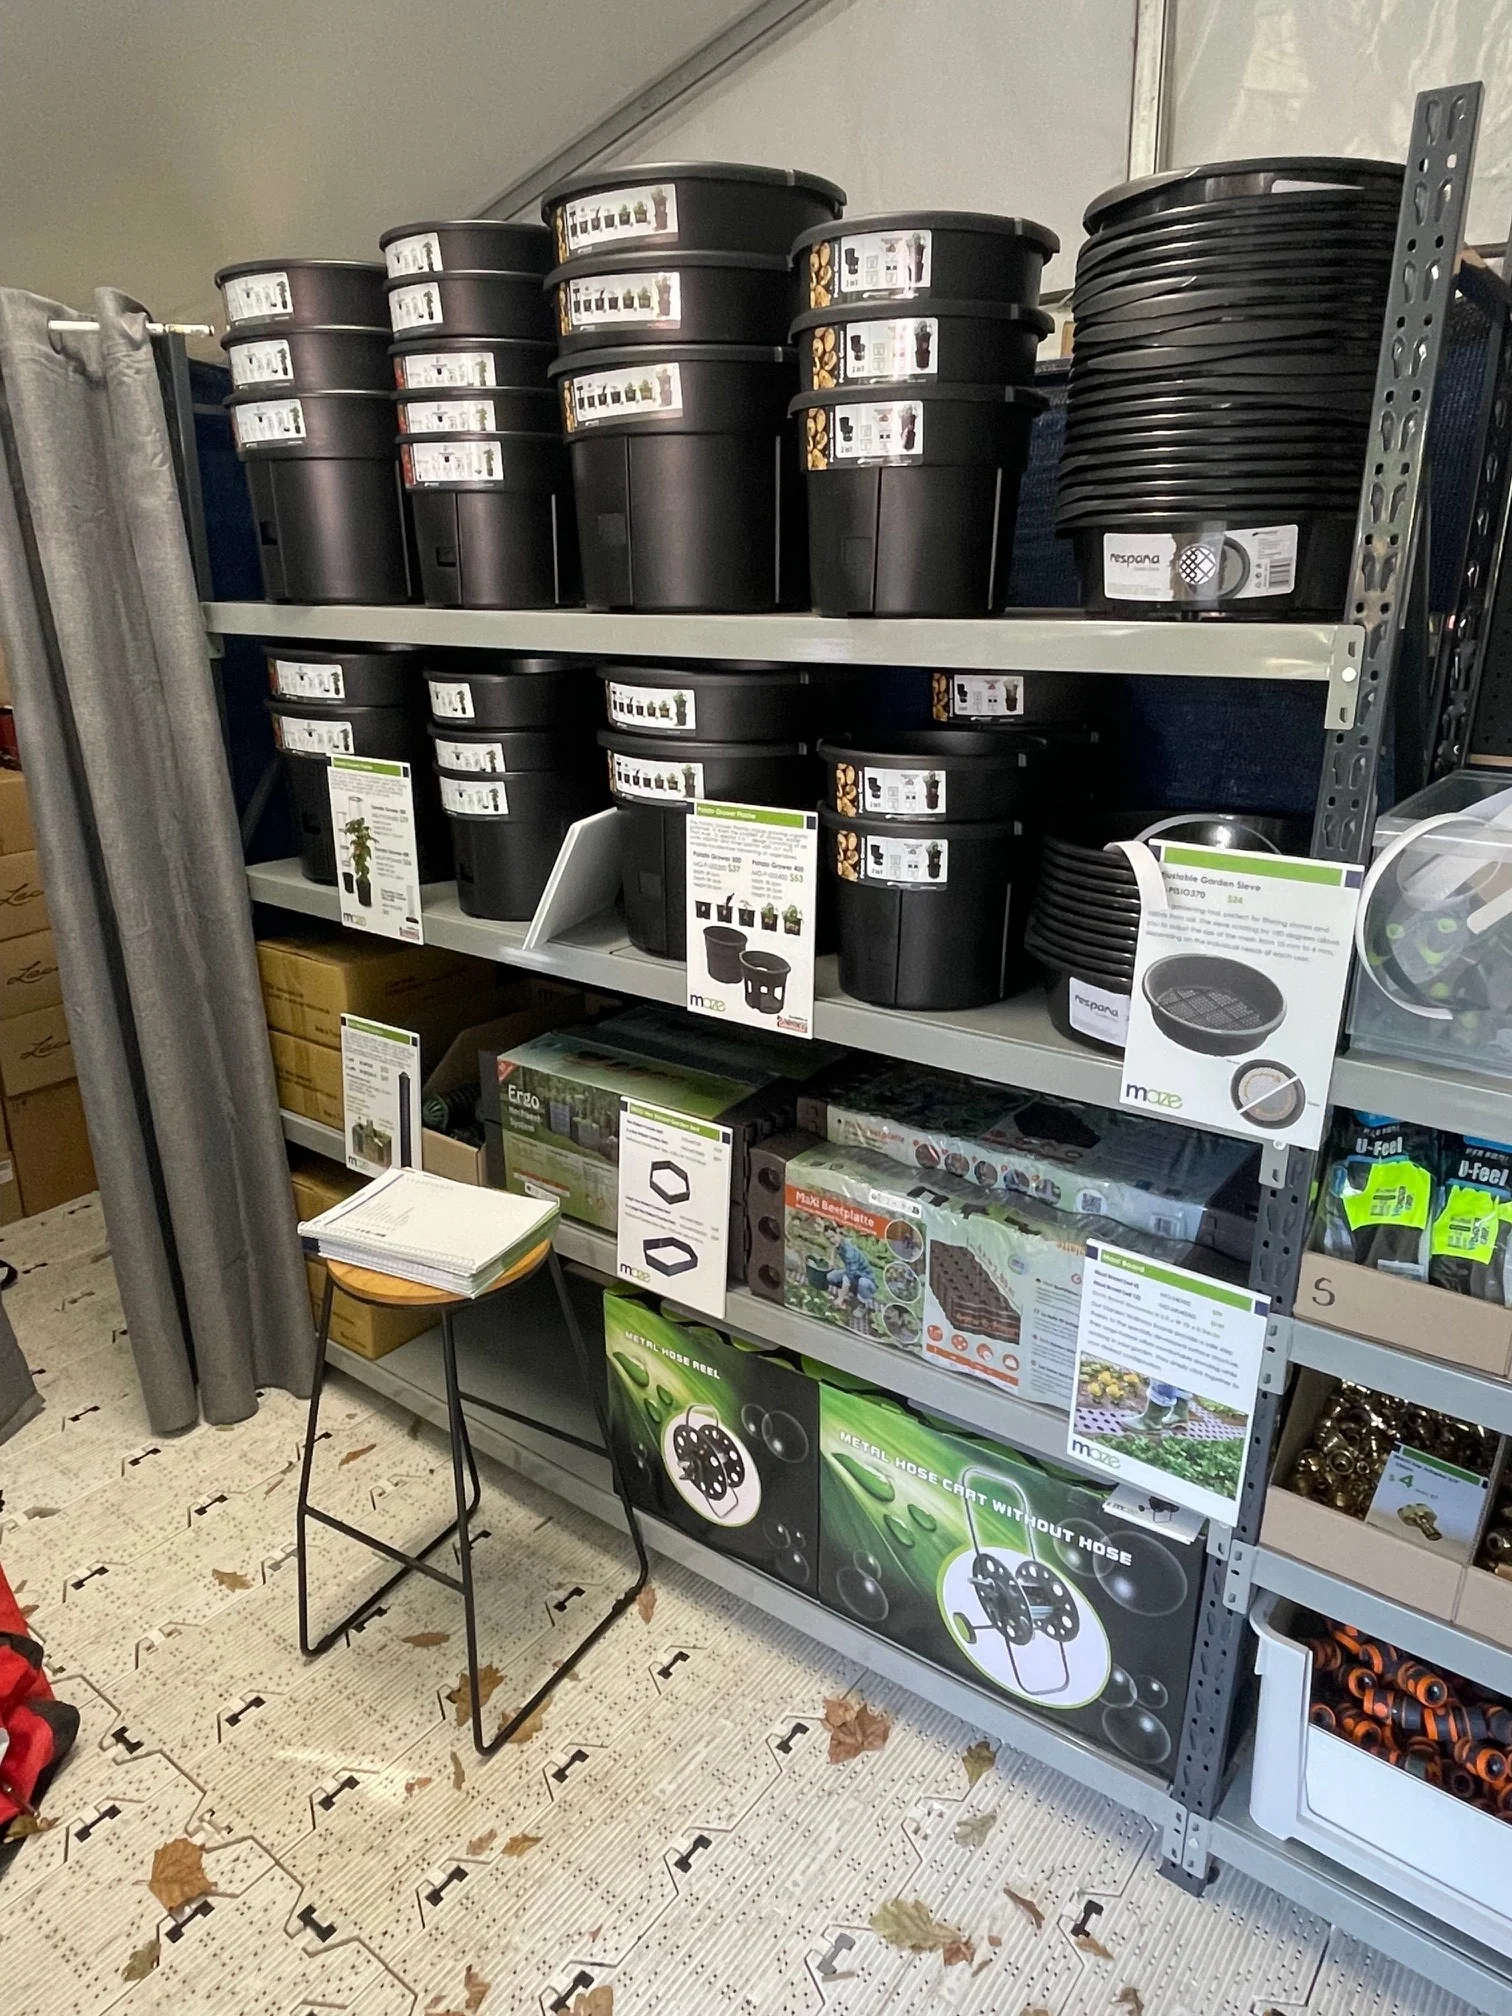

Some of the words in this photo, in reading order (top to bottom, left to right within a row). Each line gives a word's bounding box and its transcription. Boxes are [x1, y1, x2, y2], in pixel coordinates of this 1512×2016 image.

[1161, 870, 1198, 884] justable
[1200, 875, 1235, 889] Garden
[1237, 880, 1262, 892] Sieve
[690, 993, 726, 1013] maze
[508, 1084, 540, 1110] Ergo
[1126, 1083, 1183, 1110] maze
[1355, 1136, 1403, 1156] U-Feel
[1458, 1159, 1510, 1187] U-Feel
[821, 1199, 875, 1228] Beetplatte
[1122, 1259, 1145, 1273] Board
[1311, 1275, 1336, 1307] S
[625, 1330, 659, 1353] METAL
[661, 1347, 690, 1367] HOSE
[692, 1360, 721, 1380] REEL
[1072, 1439, 1122, 1470] maze
[1398, 1474, 1414, 1488] 4
[839, 1431, 890, 1464] METAL
[895, 1456, 938, 1485] HOSE
[942, 1478, 988, 1507] CART
[992, 1498, 1075, 1543] WITHOUT
[1078, 1535, 1132, 1567] HOSE
